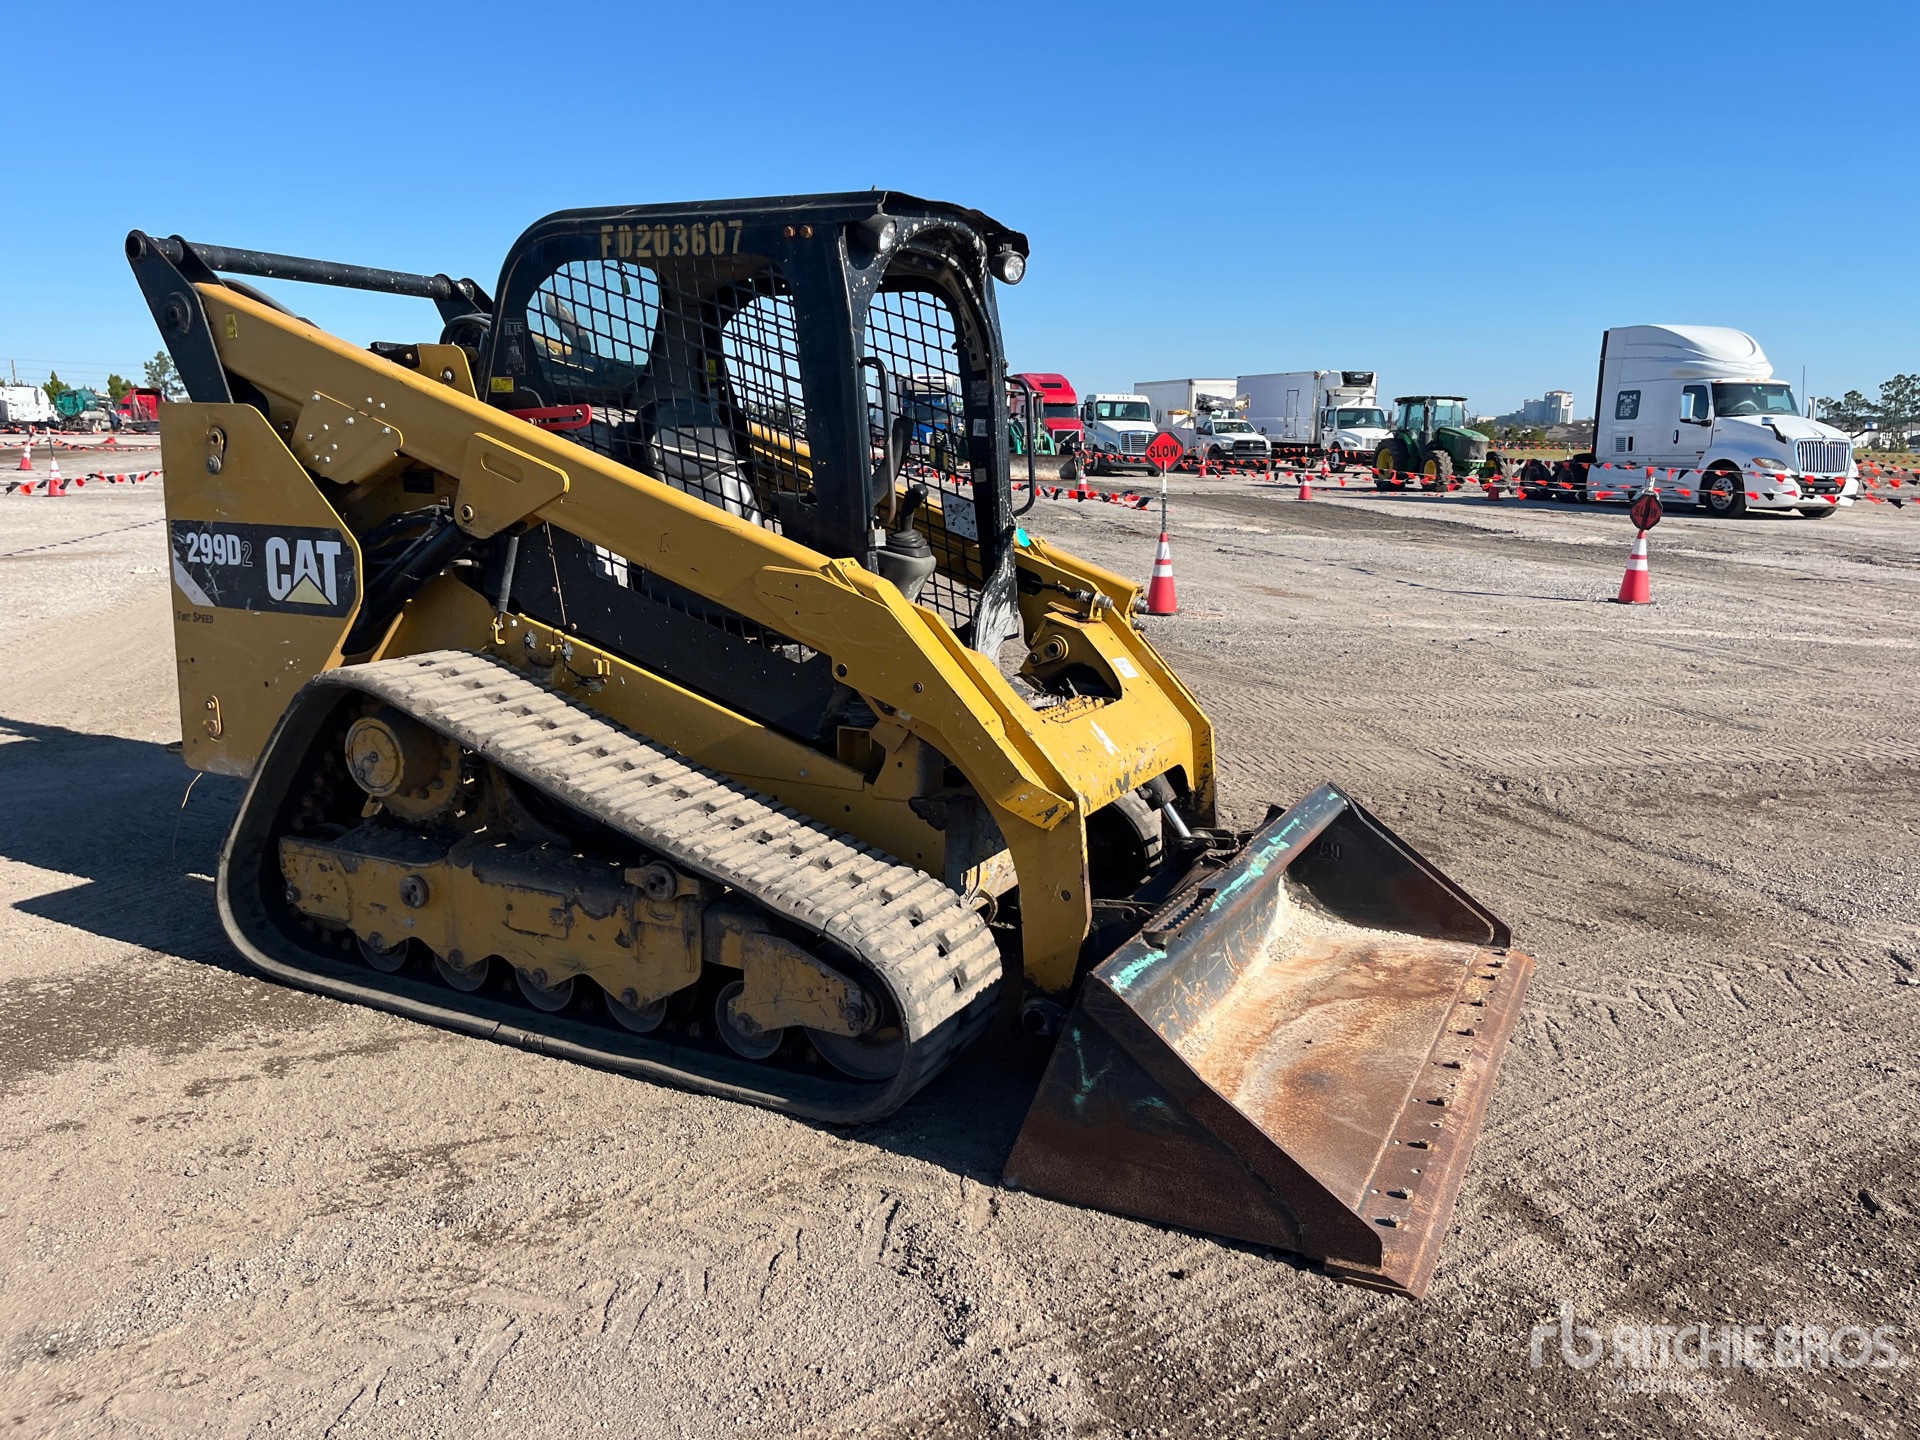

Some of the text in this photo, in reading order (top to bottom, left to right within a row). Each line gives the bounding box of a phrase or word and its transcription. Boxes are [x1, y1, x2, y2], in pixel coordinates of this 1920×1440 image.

[601, 219, 743, 258] FD203607
[1149, 445, 1178, 458] SLOW
[1634, 505, 1659, 518] SLW
[186, 532, 253, 567] 299D2
[265, 536, 342, 606] CAT
